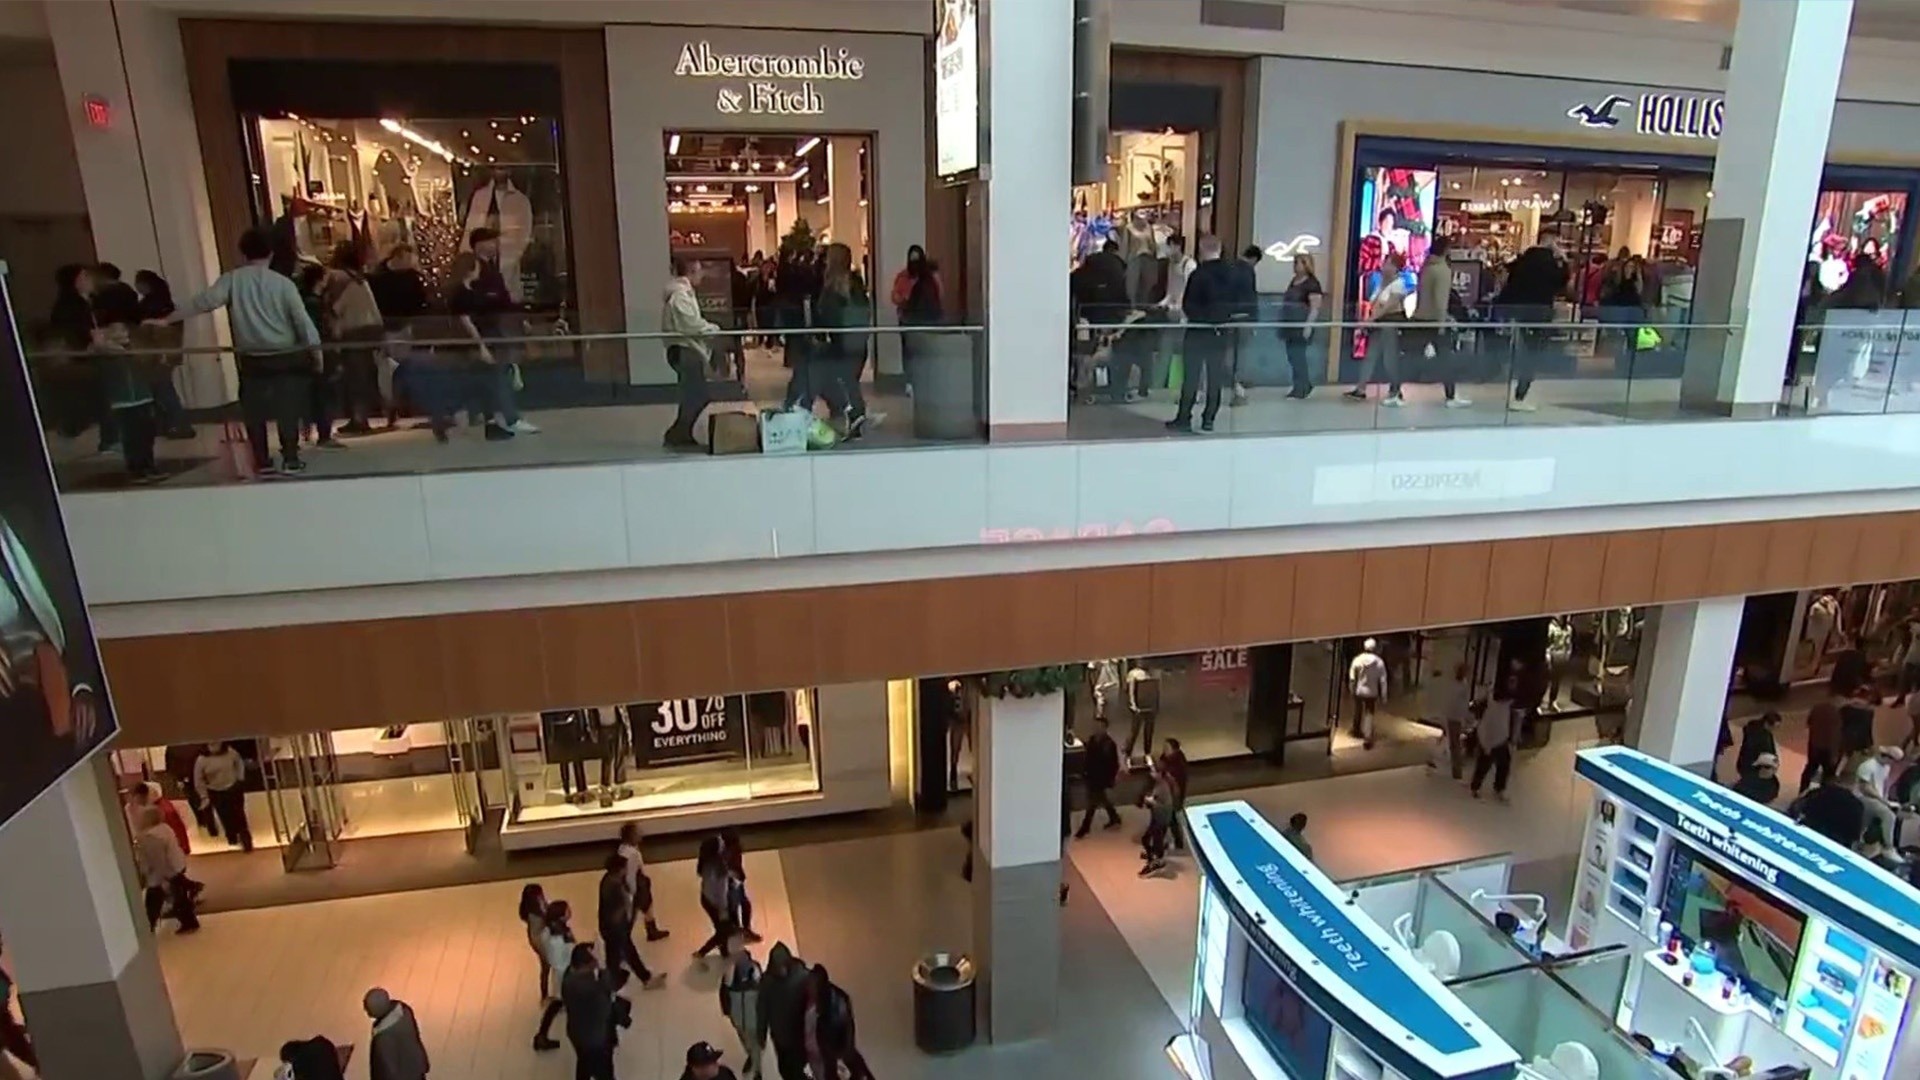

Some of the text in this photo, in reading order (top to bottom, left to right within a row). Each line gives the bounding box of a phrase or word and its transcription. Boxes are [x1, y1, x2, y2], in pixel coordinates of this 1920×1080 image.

[675, 40, 864, 79] Abercrombie
[717, 81, 824, 114] & Fitch
[1637, 93, 1726, 139] HOLLIS
[1201, 651, 1247, 670] SALE
[701, 712, 725, 729] OFF
[654, 731, 726, 748] EVERYTHING
[1677, 813, 1780, 884] Teeth whitening
[1255, 862, 1369, 972] Teeth whitening
